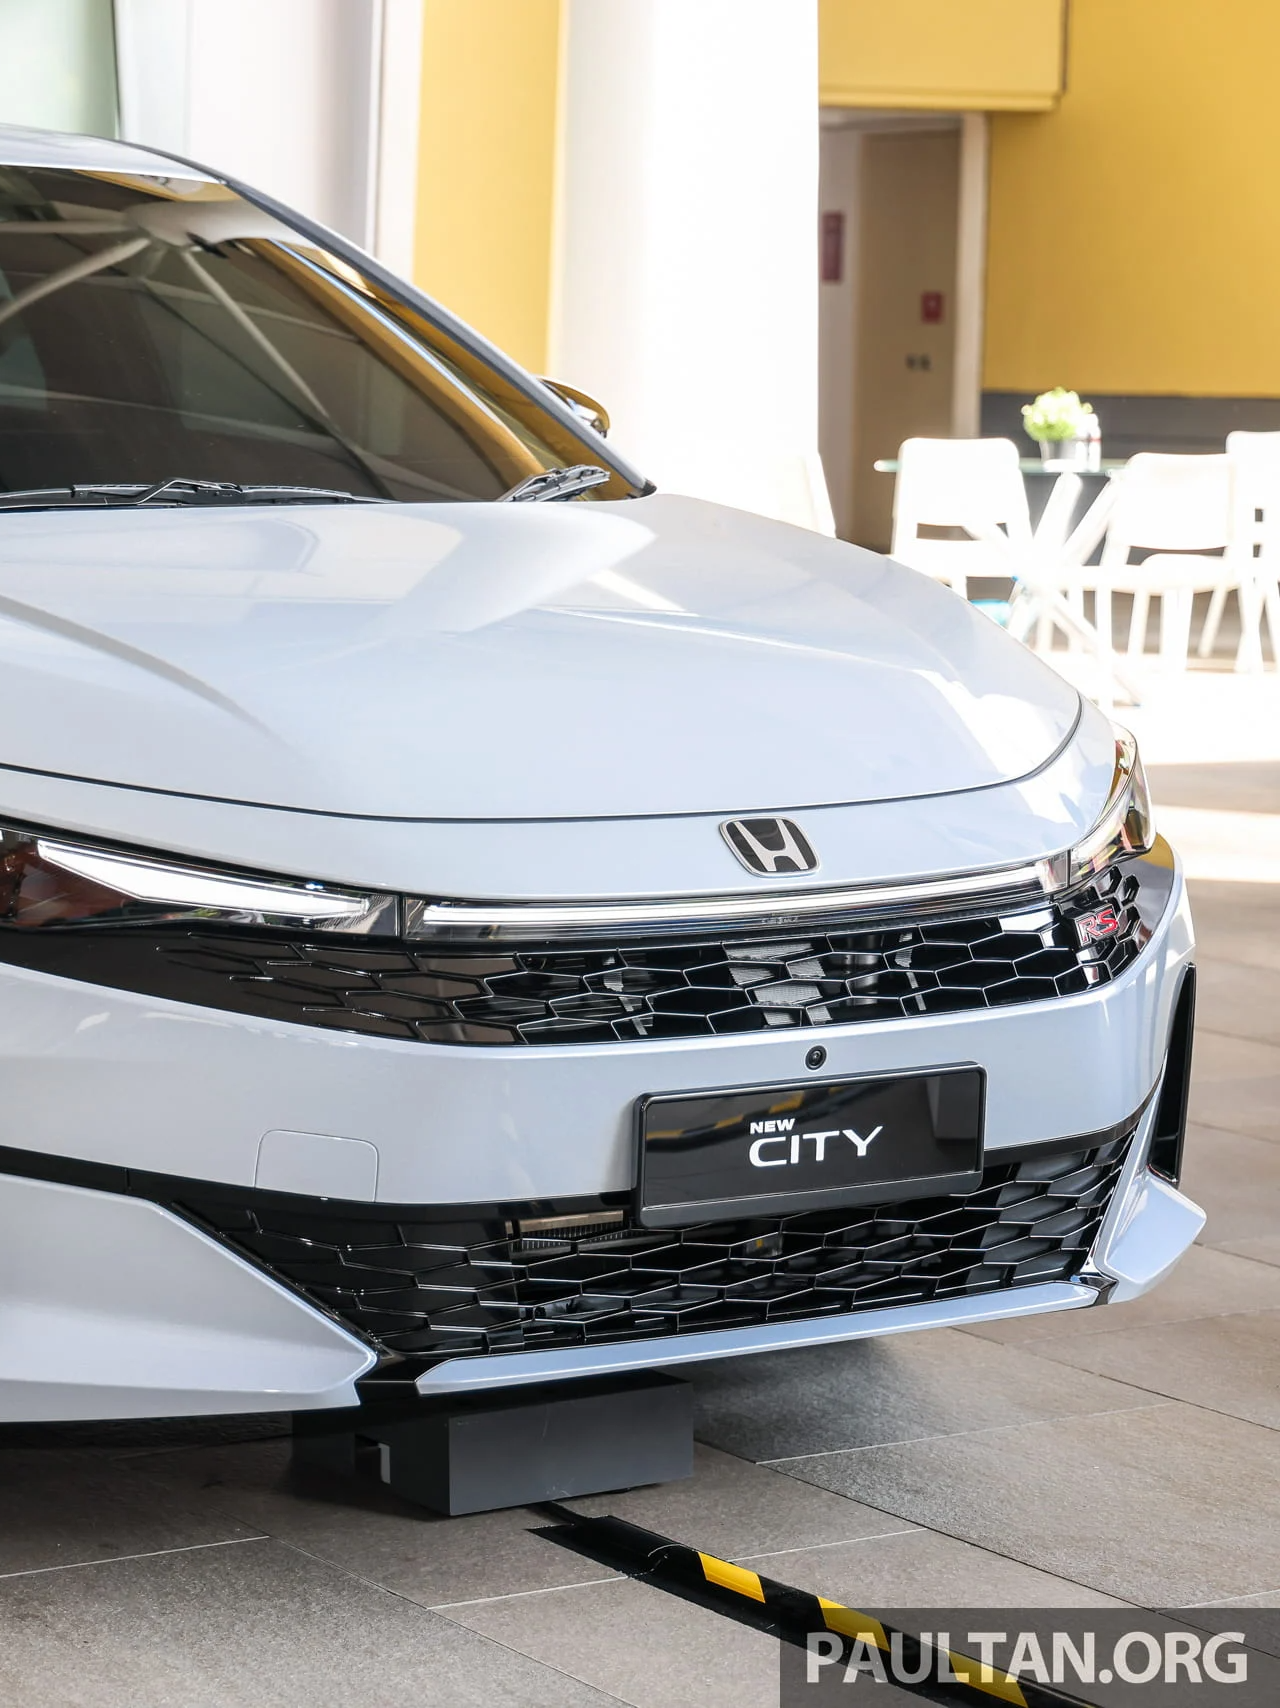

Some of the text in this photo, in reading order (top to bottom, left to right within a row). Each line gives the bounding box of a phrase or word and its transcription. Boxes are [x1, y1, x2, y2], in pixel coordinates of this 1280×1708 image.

[1077, 907, 1119, 943] RS
[749, 1118, 796, 1135] NEW
[748, 1125, 884, 1168] CITY
